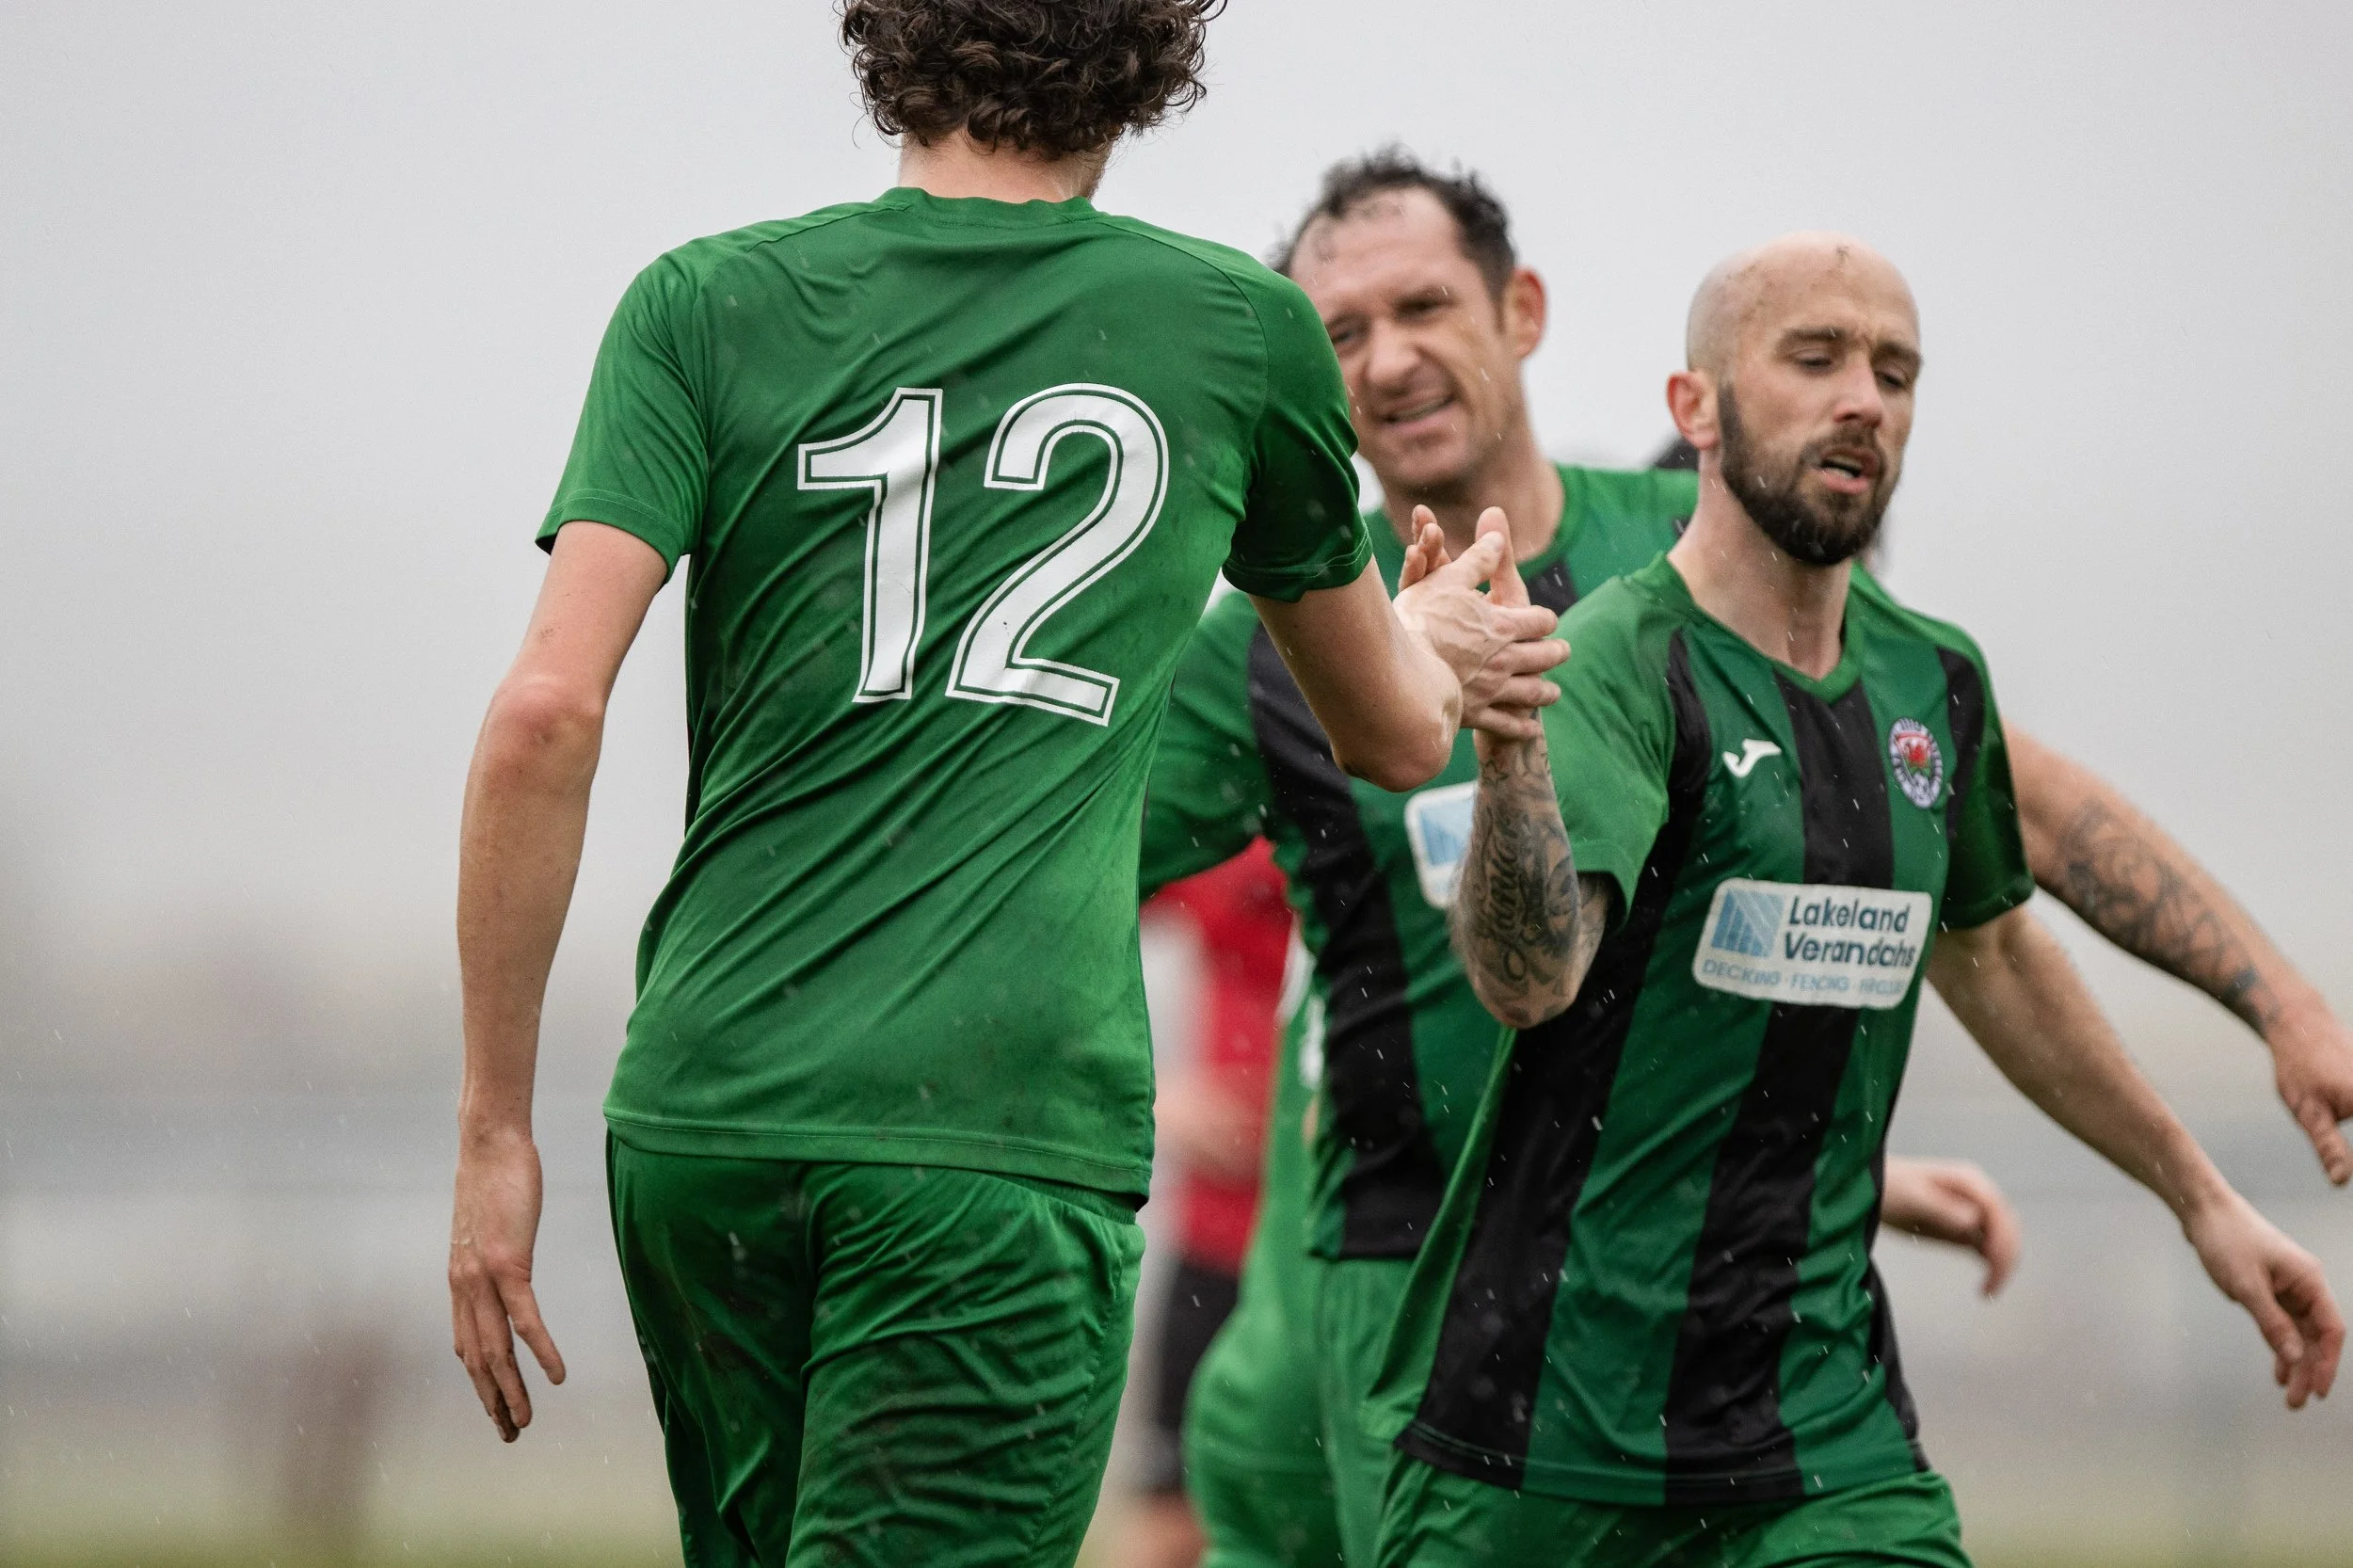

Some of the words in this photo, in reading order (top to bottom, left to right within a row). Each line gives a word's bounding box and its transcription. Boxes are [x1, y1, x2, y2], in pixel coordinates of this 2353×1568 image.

[797, 382, 1169, 727] 12
[1789, 896, 1911, 933] Lakeland
[1785, 932, 1916, 968] Verandahs
